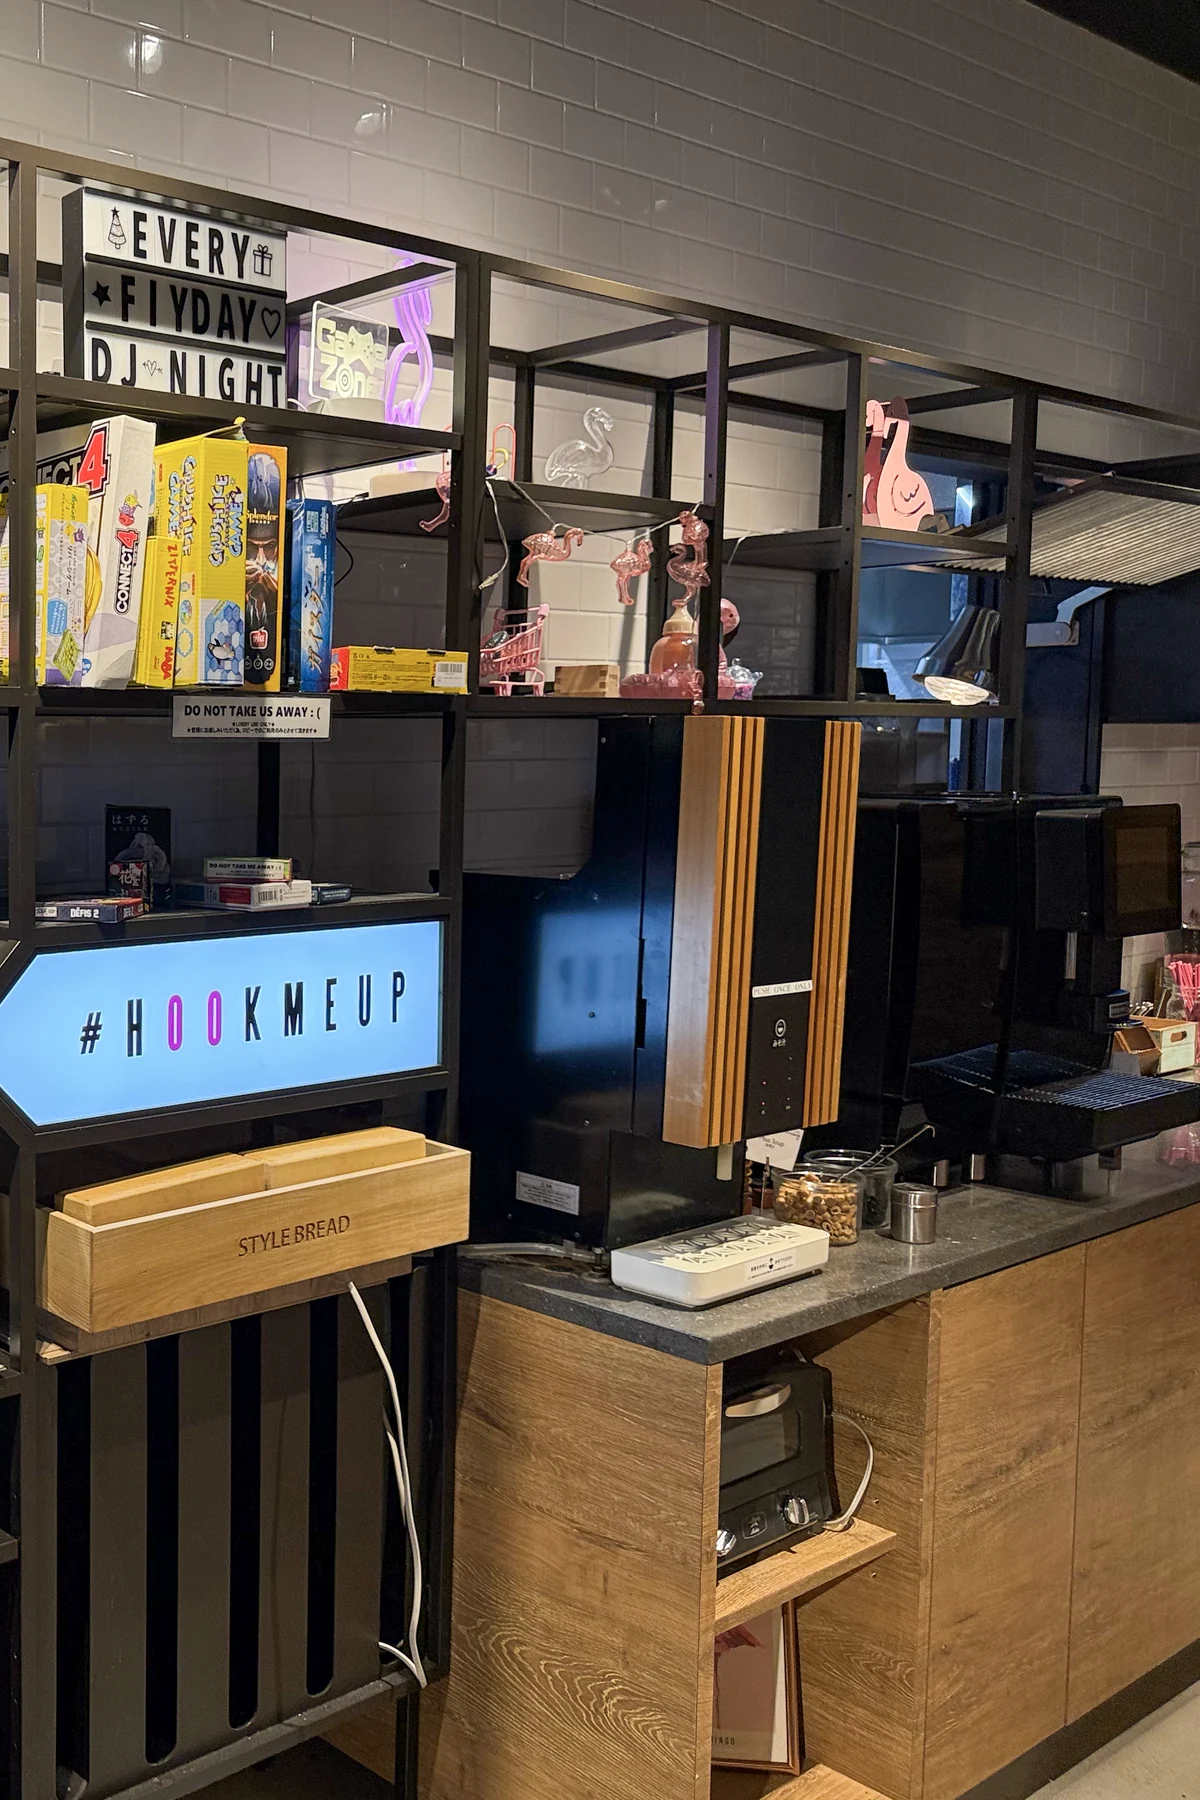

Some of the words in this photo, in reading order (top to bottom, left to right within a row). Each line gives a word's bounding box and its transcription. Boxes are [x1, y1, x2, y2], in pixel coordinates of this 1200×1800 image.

[132, 211, 250, 279] EVERY
[91, 338, 136, 387] DJ
[169, 351, 282, 409] NIGHT
[77, 431, 105, 492] 4
[247, 509, 278, 524] Splendor
[116, 529, 139, 551] 4
[115, 543, 134, 614] CONNECT
[164, 544, 178, 608] ZITTERNIX
[161, 646, 174, 681] HABA
[184, 705, 200, 716] DO
[204, 706, 226, 716] NOT
[230, 706, 256, 717] TAKE
[260, 707, 273, 717] US
[276, 707, 308, 717] AWAY
[70, 907, 92, 918] DÉFIS
[93, 909, 100, 918] 2
[754, 986, 770, 996] PUSH
[774, 985, 790, 993] ONCE
[795, 982, 812, 991] ONLY
[237, 1227, 290, 1257] STYLE
[294, 1215, 351, 1244] BREAD
